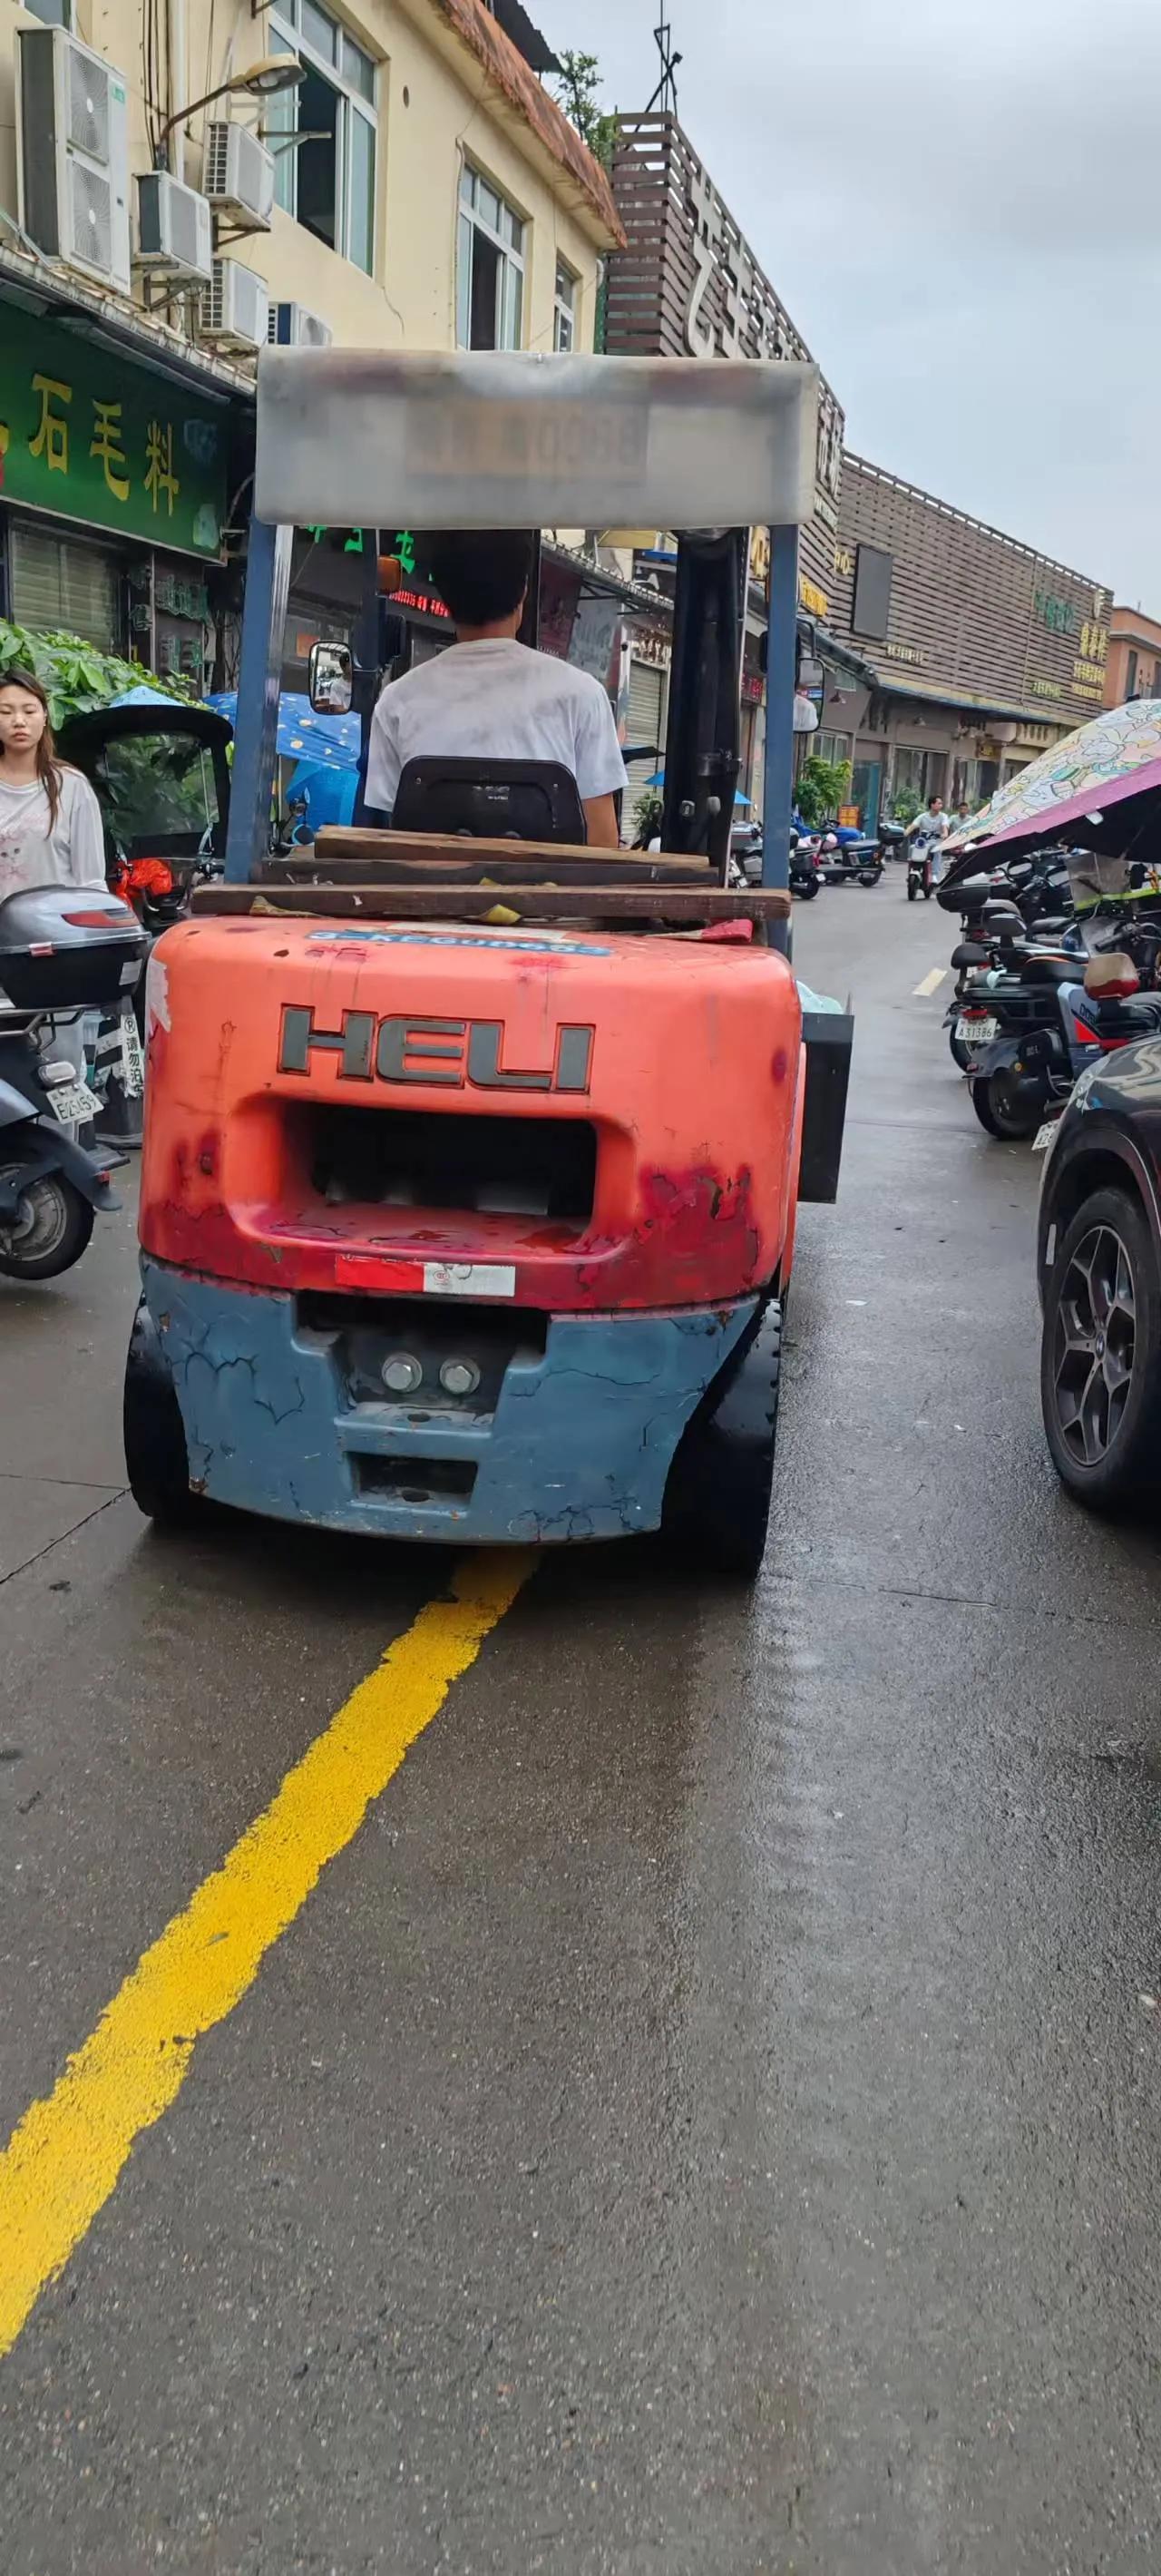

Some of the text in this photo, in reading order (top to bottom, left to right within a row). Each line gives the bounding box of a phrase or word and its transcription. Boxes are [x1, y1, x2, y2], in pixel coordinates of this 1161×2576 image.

[0, 373, 180, 516] 石毛料
[280, 1005, 593, 1092] HELI
